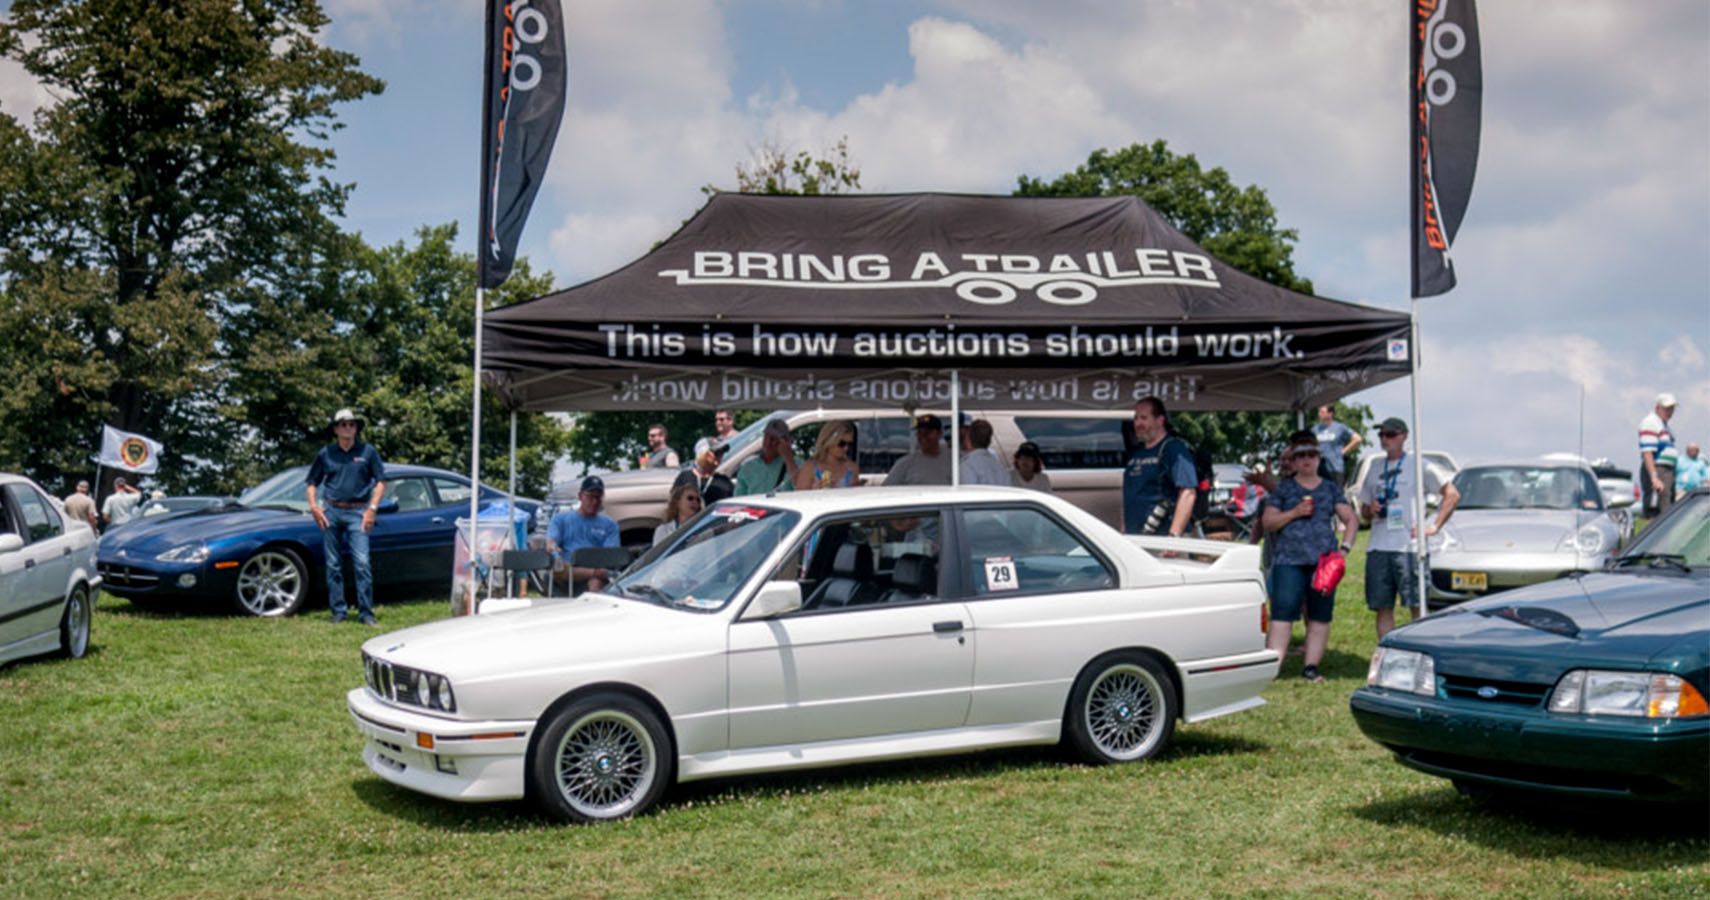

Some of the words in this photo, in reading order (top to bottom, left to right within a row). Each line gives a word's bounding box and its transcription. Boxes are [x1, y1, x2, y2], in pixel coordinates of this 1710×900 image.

[694, 251, 891, 281] BRING
[910, 252, 950, 280] A
[961, 248, 1217, 281] TRAILER
[598, 324, 686, 357] This
[703, 324, 736, 356] is
[753, 324, 837, 356] how
[853, 324, 1030, 356] auctions
[1045, 326, 1179, 357] should
[1193, 326, 1304, 358] work.
[991, 566, 1011, 583] 29
